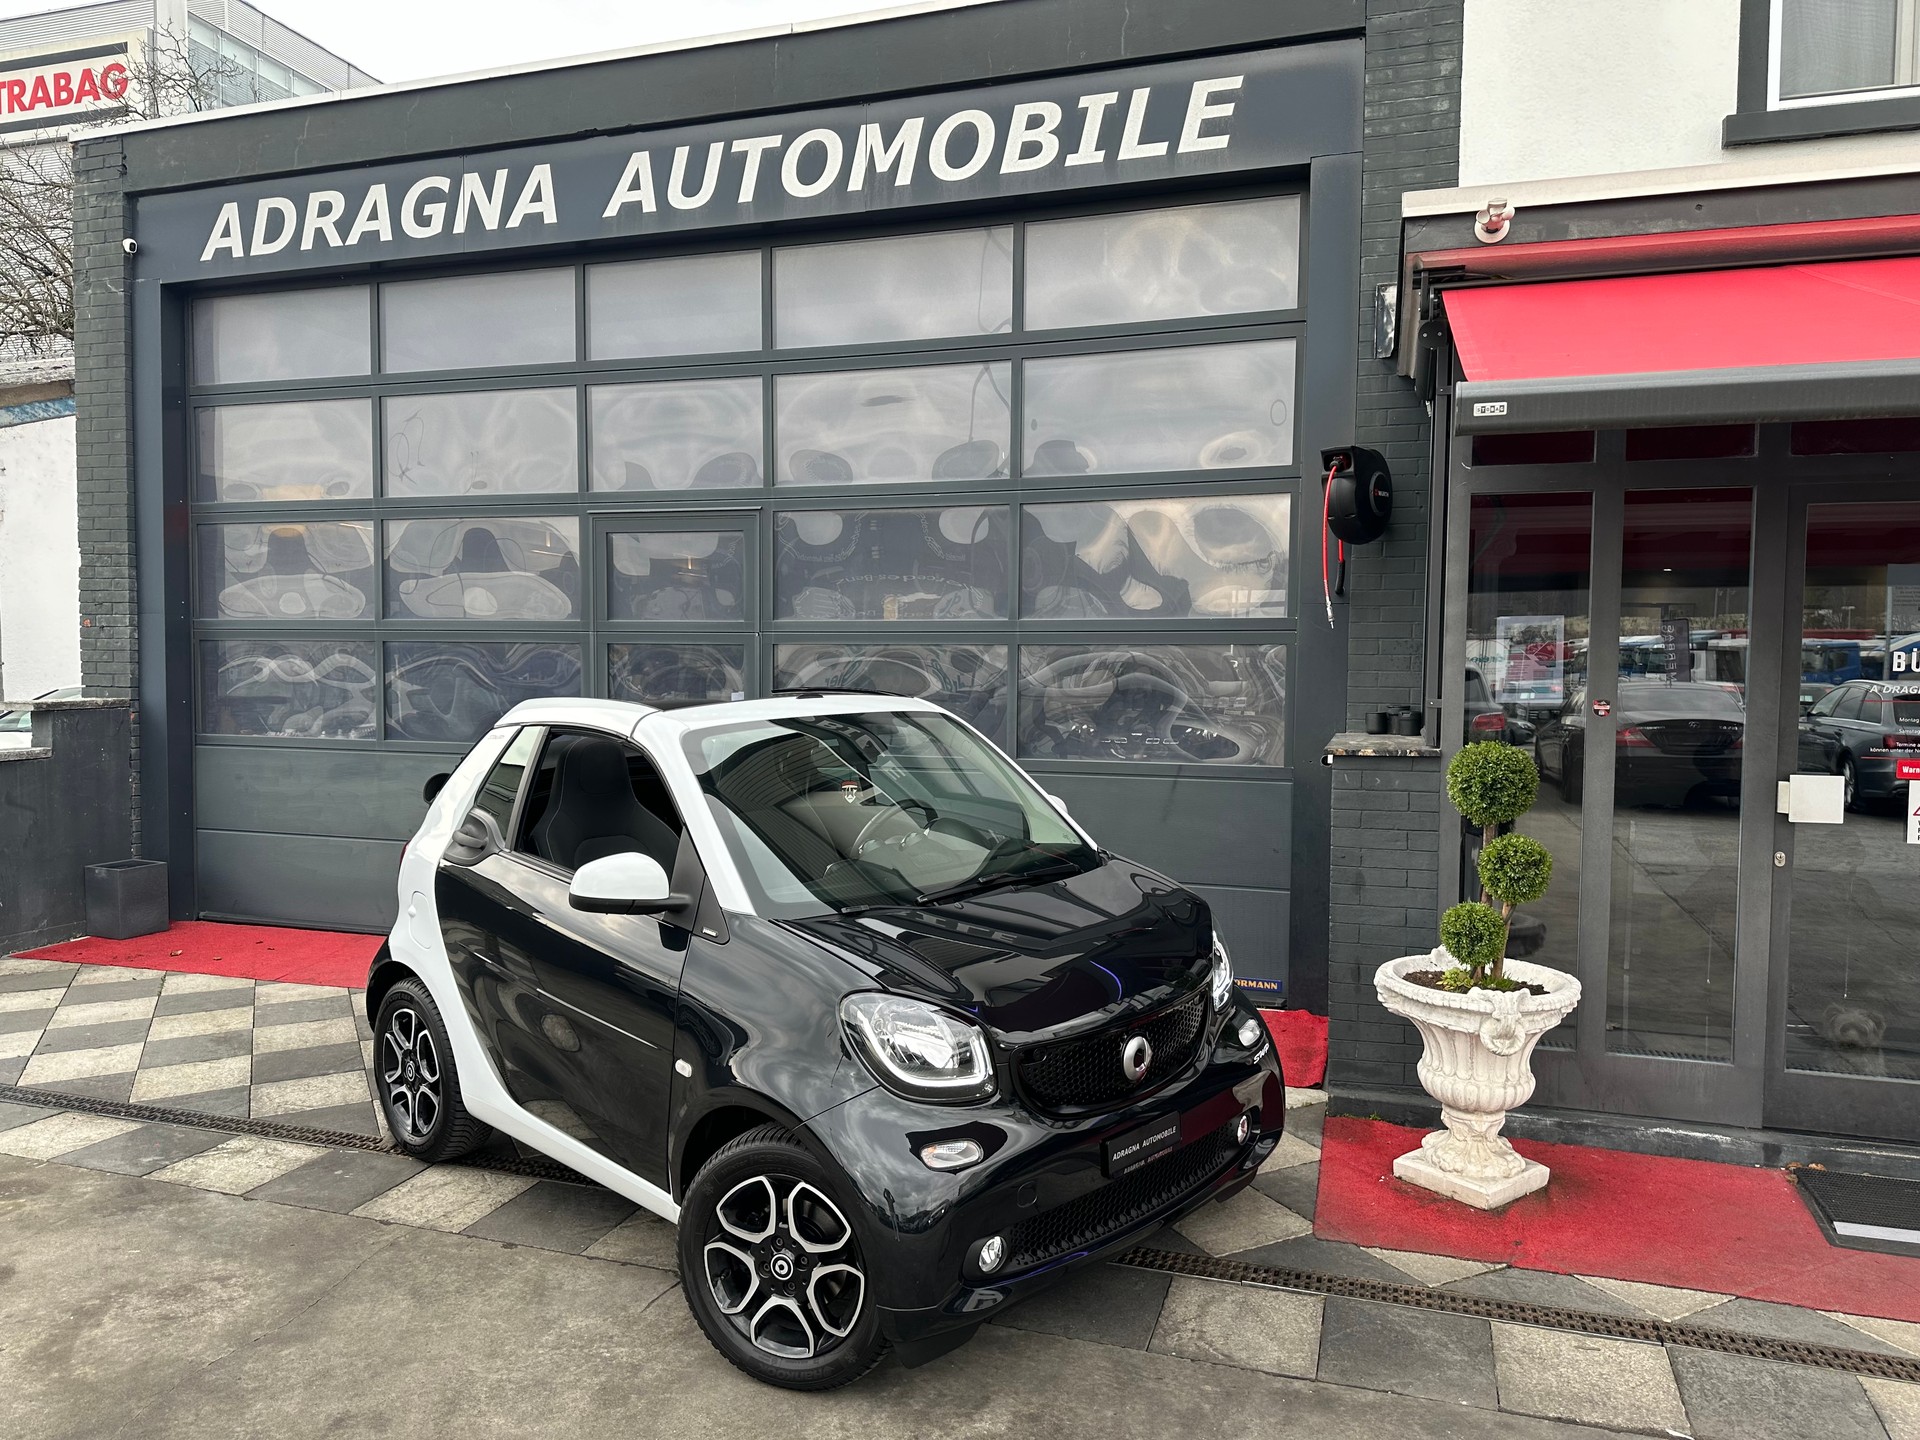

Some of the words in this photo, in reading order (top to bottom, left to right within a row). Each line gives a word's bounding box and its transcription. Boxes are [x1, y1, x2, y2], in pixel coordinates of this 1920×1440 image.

[200, 163, 558, 262] ADRAGNA
[602, 75, 1244, 218] AUTOMOBILE
[1112, 1143, 1140, 1161] ADRAGNA
[1142, 1126, 1177, 1148] AUTOMOBILE
